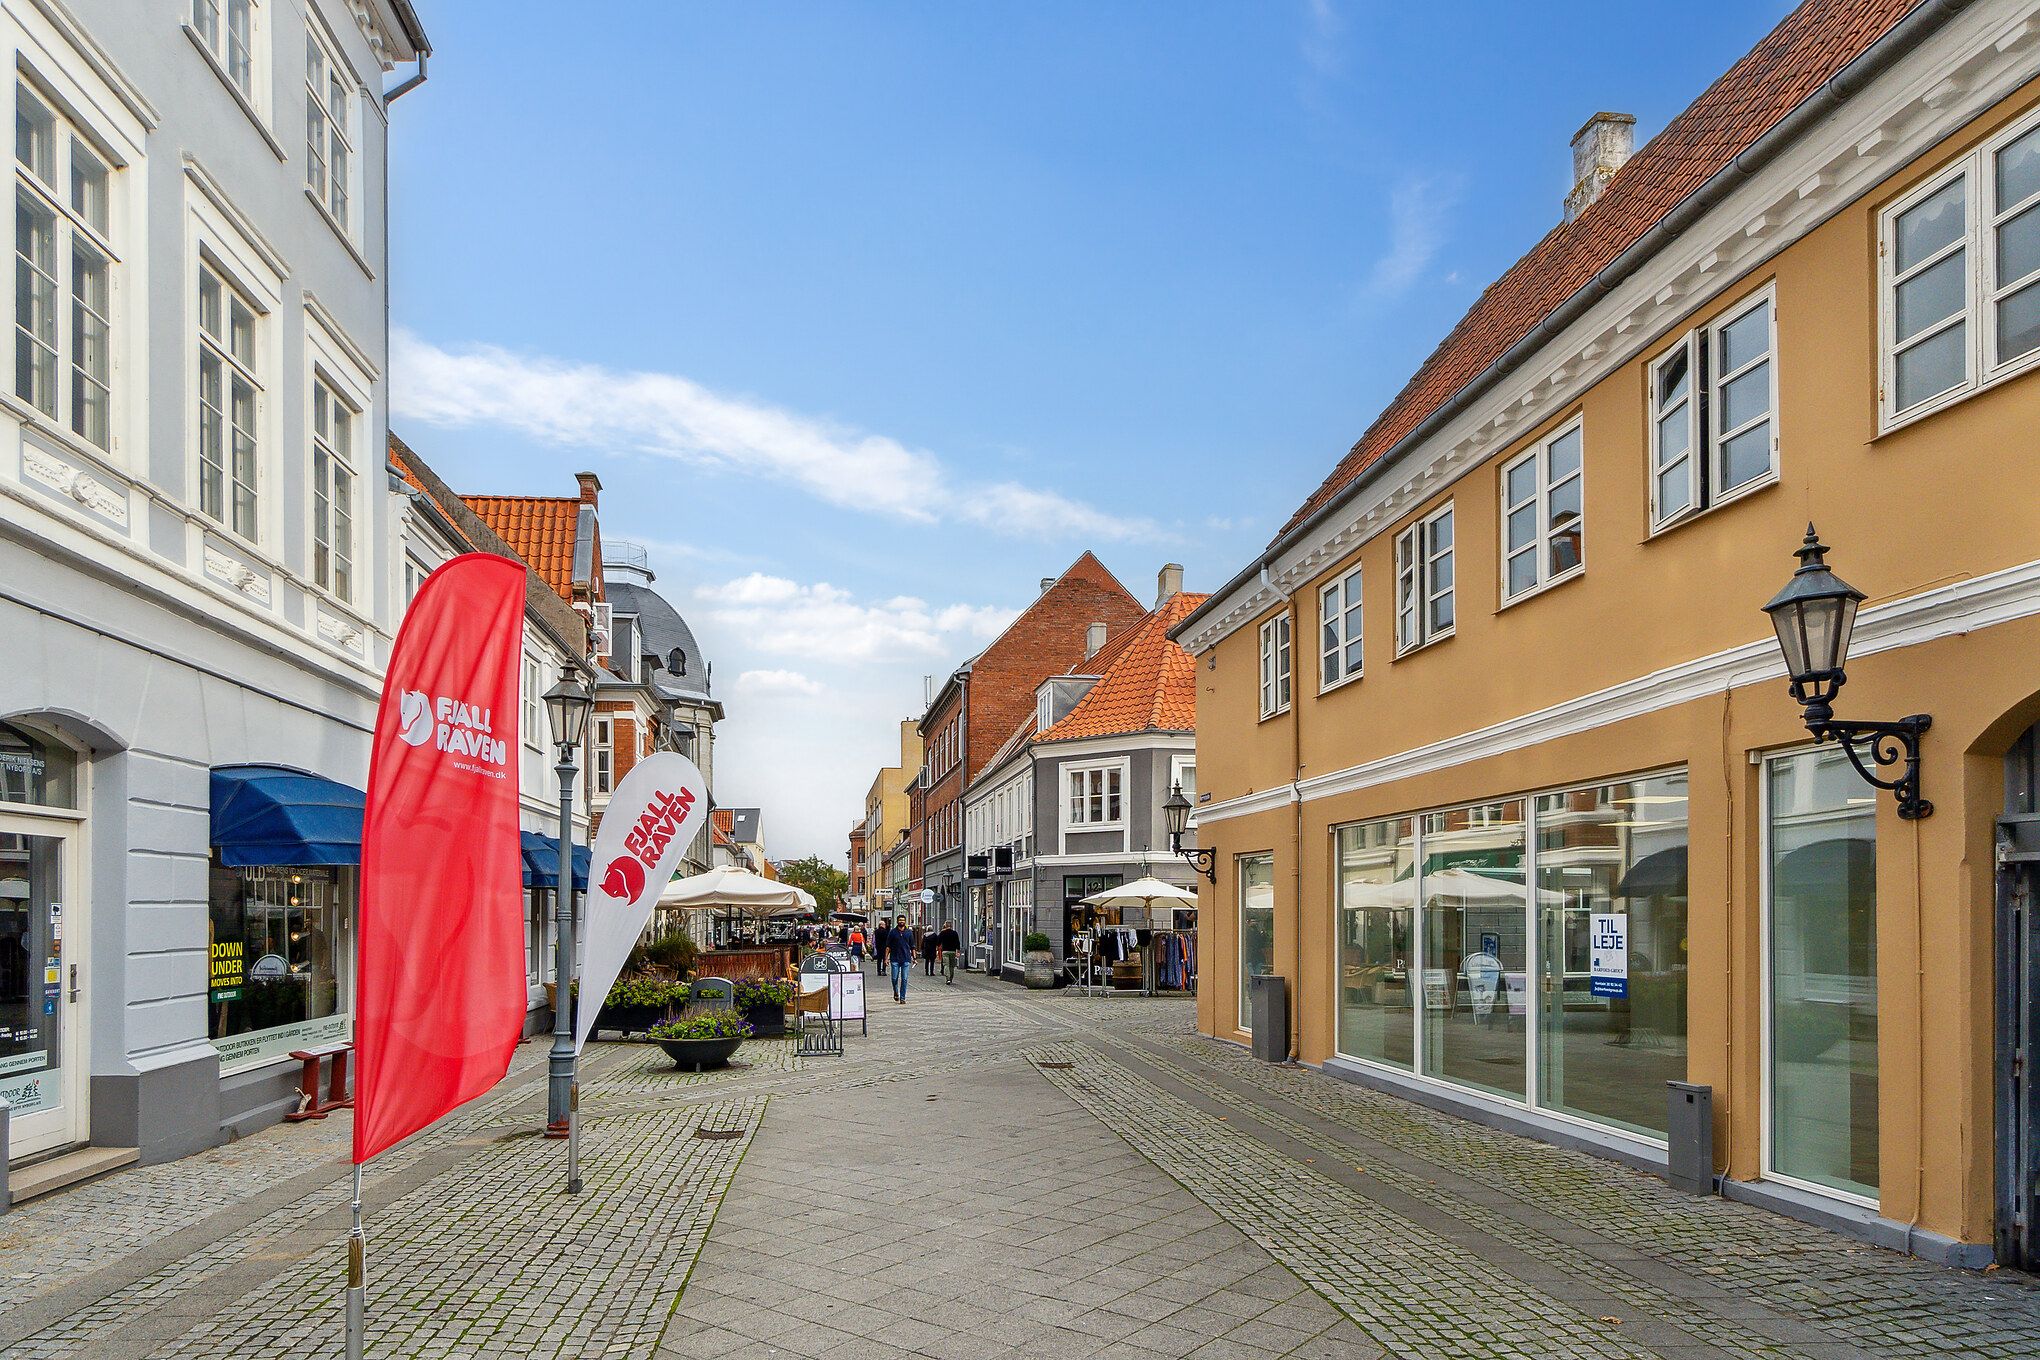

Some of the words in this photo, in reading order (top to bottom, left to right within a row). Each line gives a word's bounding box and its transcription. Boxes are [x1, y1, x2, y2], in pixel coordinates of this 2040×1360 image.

[436, 696, 492, 734] FJÄLL
[436, 723, 507, 767] RÄVEN
[624, 789, 675, 857] FJÄLL
[639, 786, 696, 870] RÄVEN
[1598, 919, 1618, 934] TIL
[211, 942, 243, 958] DOWN
[1593, 934, 1624, 950] LEJE
[211, 960, 243, 976] UNDER
[210, 977, 230, 988] MOVES
[230, 976, 243, 986] INTO
